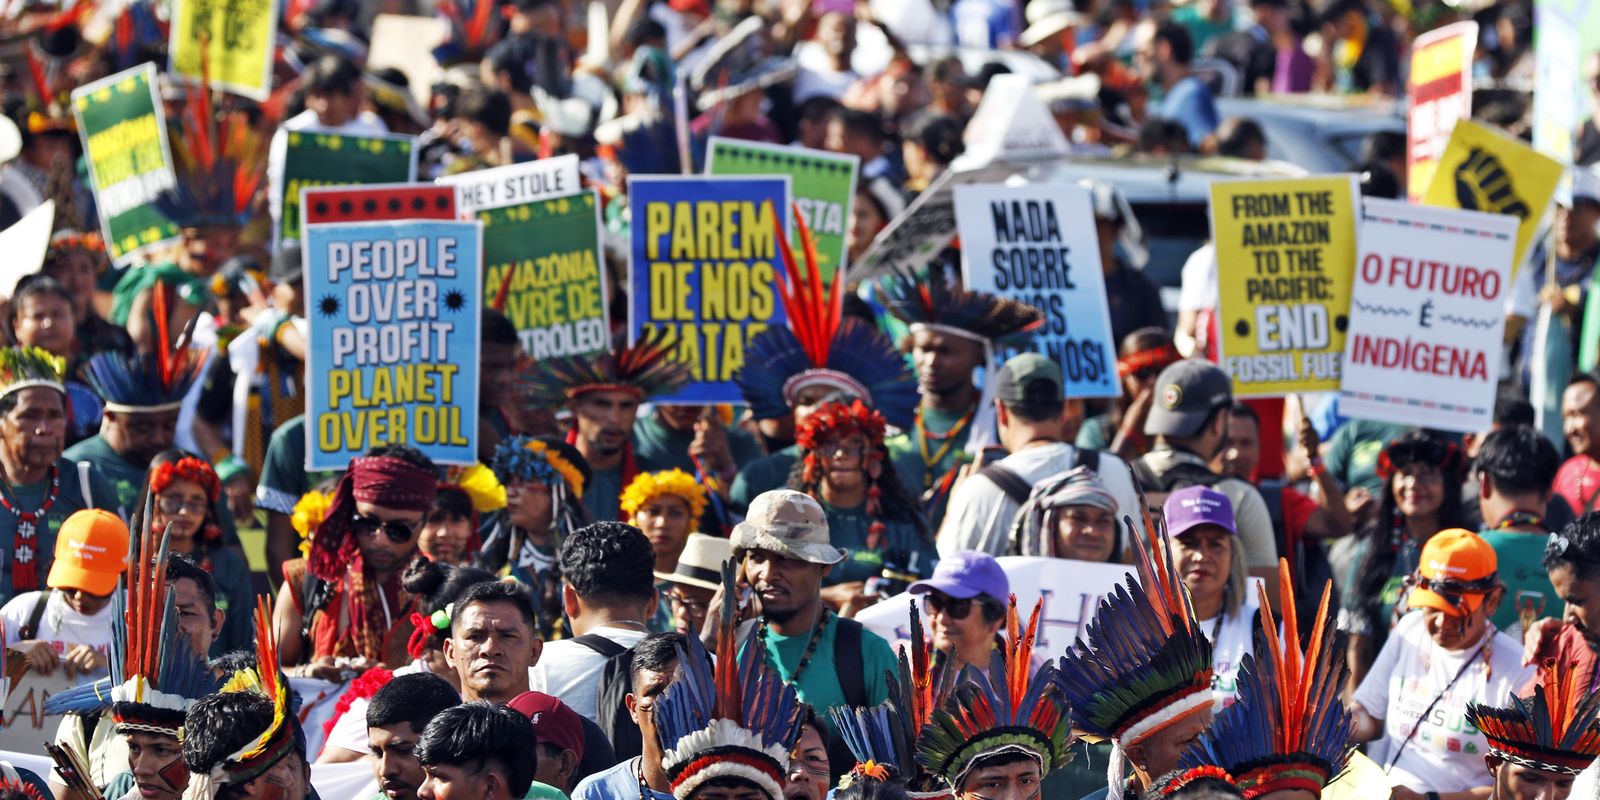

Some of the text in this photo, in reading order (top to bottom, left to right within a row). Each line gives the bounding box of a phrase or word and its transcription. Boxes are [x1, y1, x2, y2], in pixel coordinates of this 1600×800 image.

[504, 168, 565, 199] STOLE
[1231, 190, 1335, 220] FROM THE
[647, 201, 775, 259] PAREM
[991, 200, 1063, 243] NADA
[1242, 220, 1331, 248] AMAZON
[327, 237, 457, 283] PEOPLE
[992, 248, 1077, 291] SOBRE
[1253, 248, 1324, 275] TO THE
[1361, 253, 1502, 302] O FUTURO
[347, 278, 438, 324] OVER
[567, 280, 603, 321] DE
[650, 261, 775, 321] DE NOS
[1246, 276, 1334, 303] PACIFIC:
[1255, 302, 1331, 351] END
[1418, 297, 1435, 328] É
[332, 321, 454, 366] PROFIT
[1351, 334, 1489, 382] INDÍGENA
[328, 362, 459, 409] PLANET
[1226, 353, 1299, 385] FOSSIL
[318, 404, 469, 453] OVER OIL
